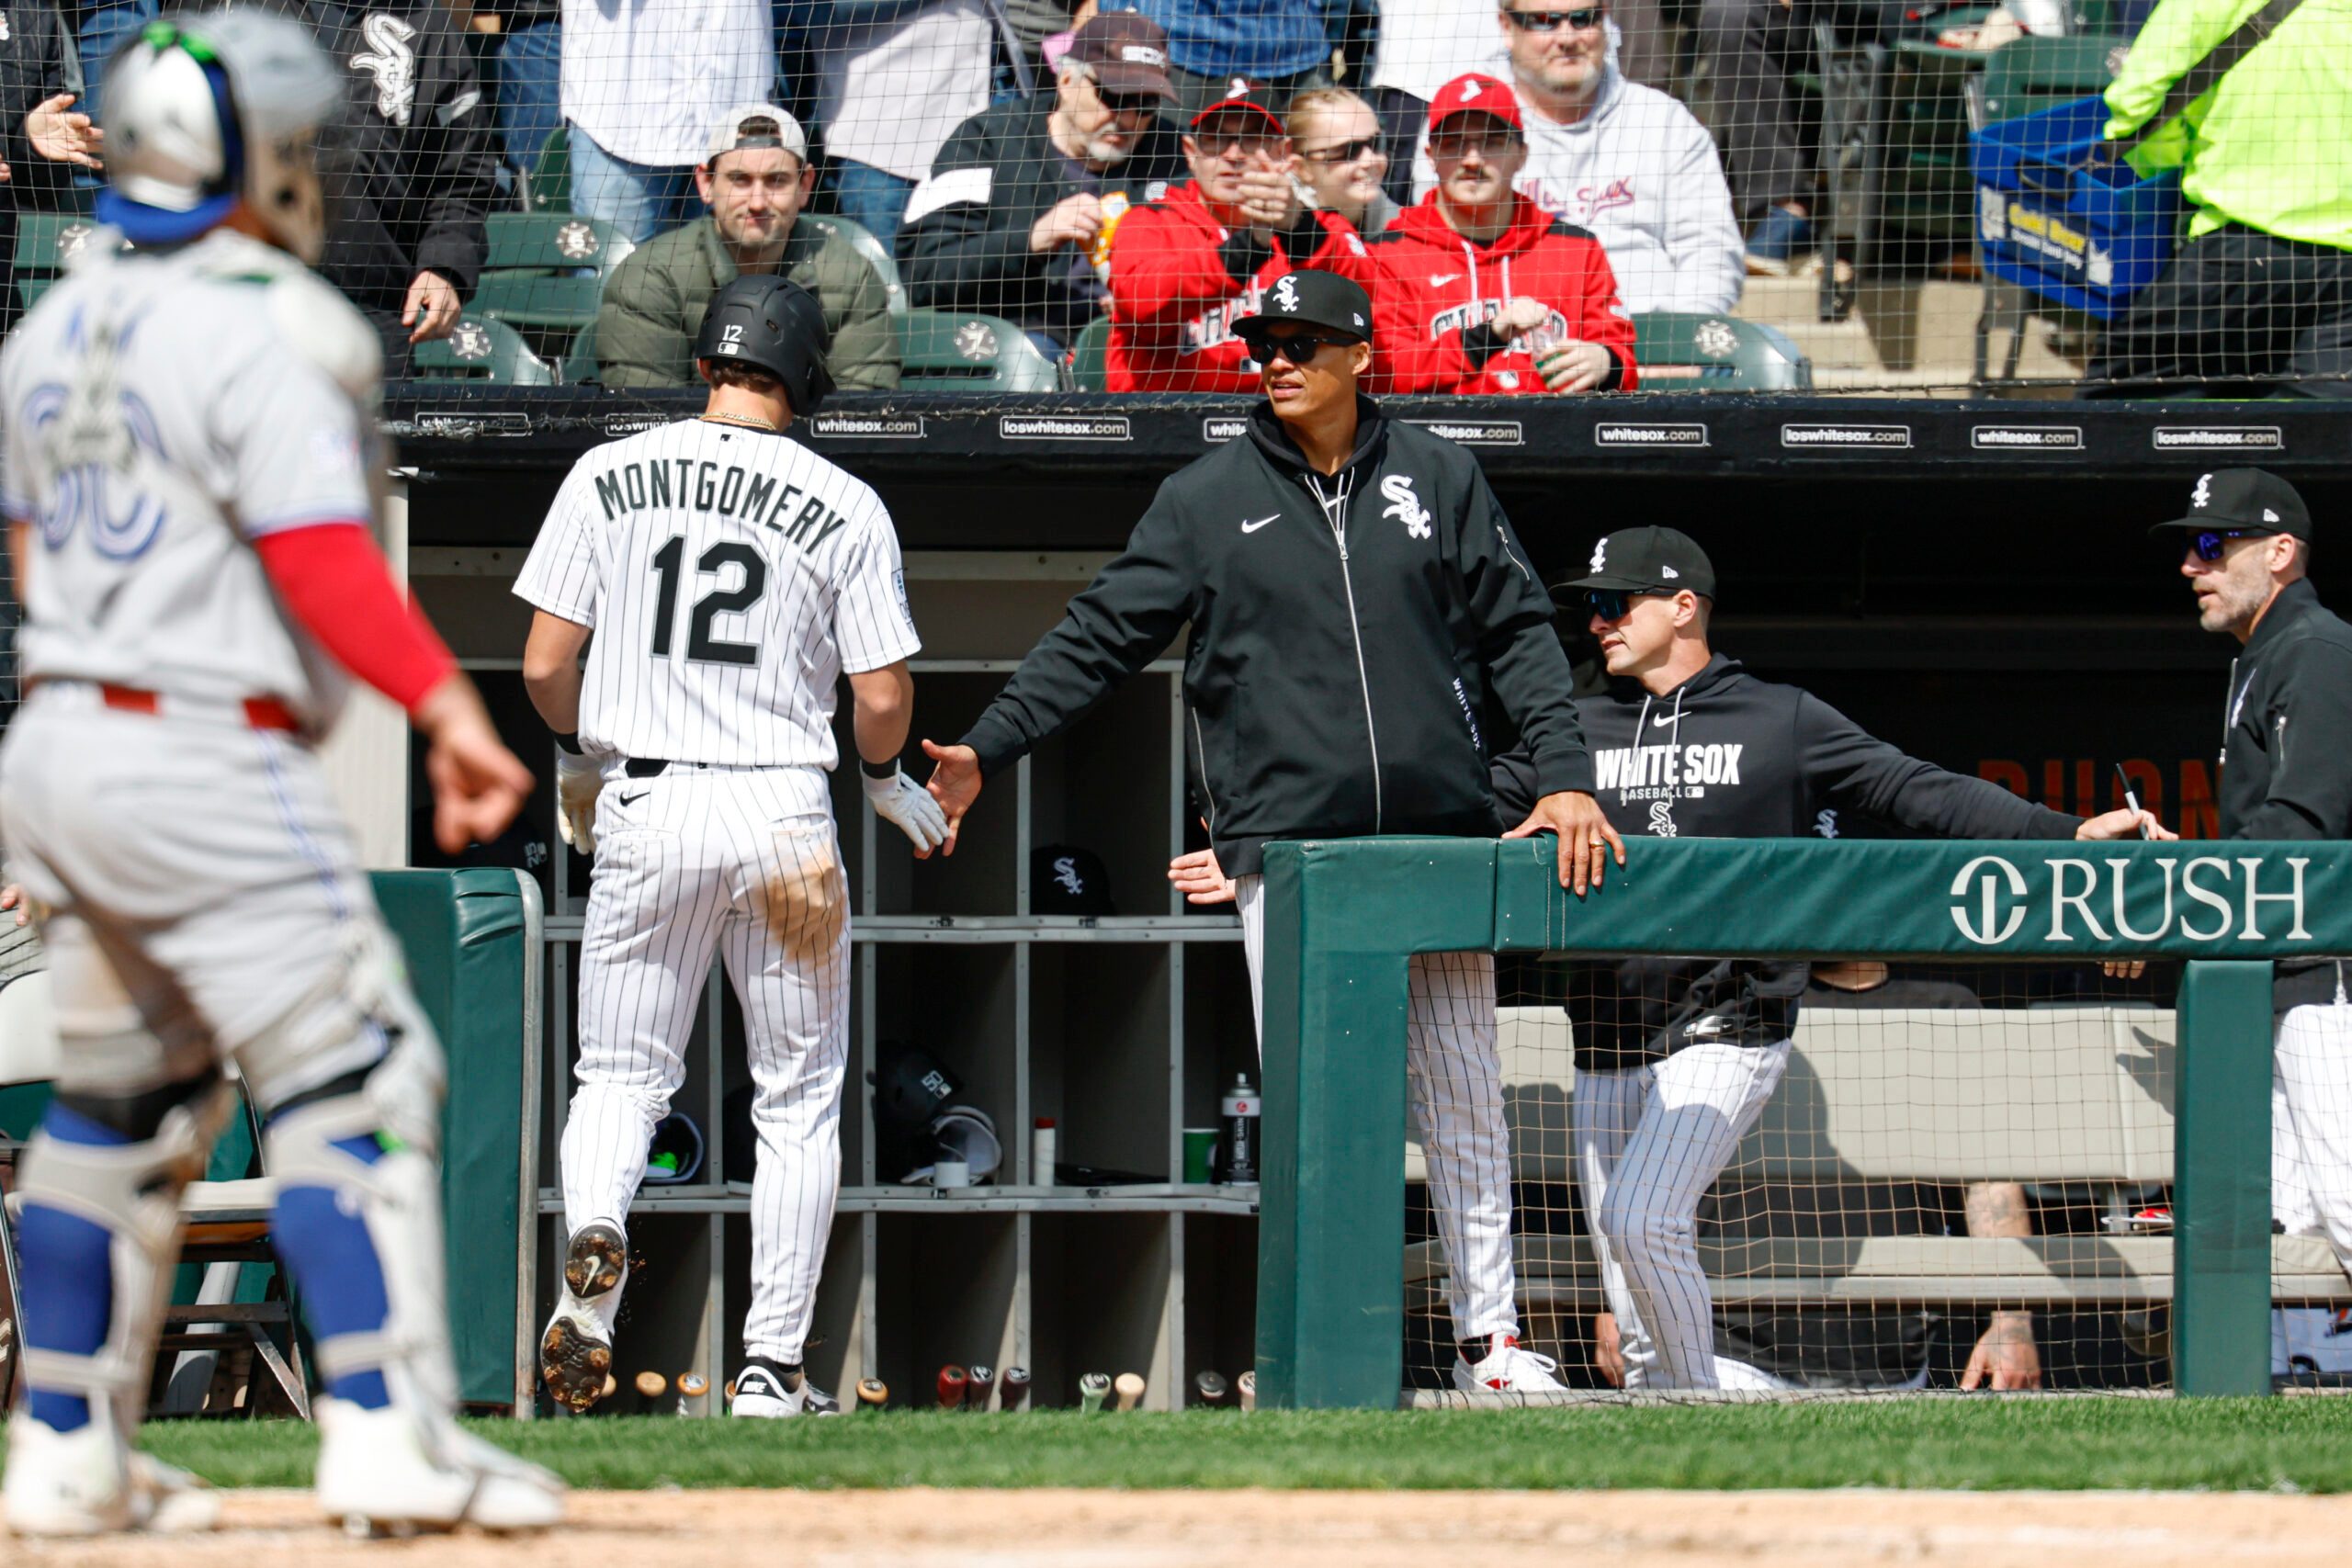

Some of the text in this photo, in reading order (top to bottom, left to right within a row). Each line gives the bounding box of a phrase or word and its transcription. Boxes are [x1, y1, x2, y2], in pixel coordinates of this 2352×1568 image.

[722, 324, 741, 343] 12
[818, 419, 917, 433] whitesox.com
[1004, 421, 1125, 434] loswhitesox.com
[1601, 427, 1700, 441] whitesox.com
[1786, 429, 1905, 443] loswhitesox.com
[1977, 431, 2075, 444] whitesox.com
[2158, 431, 2277, 446] loswhitesox.com
[594, 459, 846, 555] MONTGOMERY
[649, 533, 770, 669] 12
[1453, 678, 1480, 751] WHITE SOX
[1596, 744, 1743, 790] WHITE SOX
[2043, 856, 2312, 942] RUSH
[741, 1381, 767, 1393] NIKE
